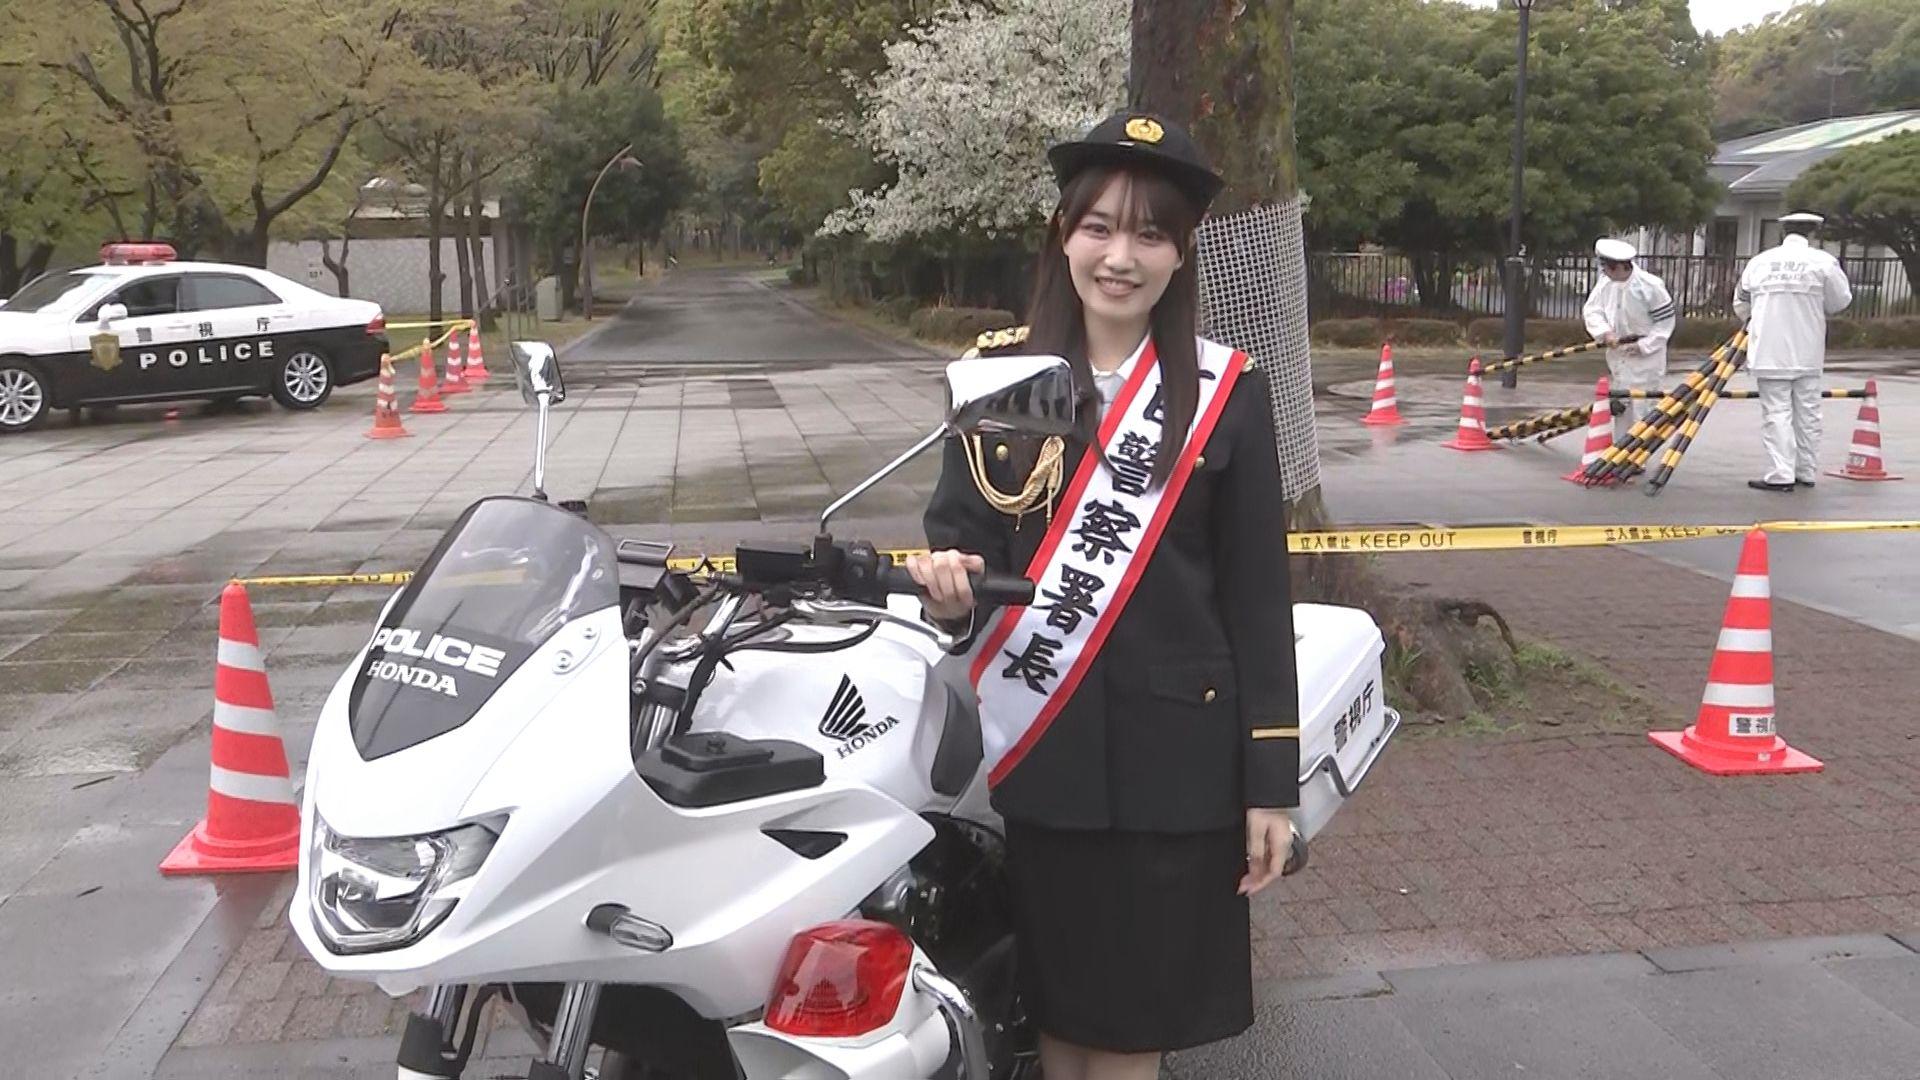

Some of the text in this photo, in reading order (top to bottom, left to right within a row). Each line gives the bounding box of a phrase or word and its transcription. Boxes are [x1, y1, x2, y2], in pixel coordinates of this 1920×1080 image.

[139, 340, 274, 370] POLICE
[1001, 368, 1217, 698] 警察署長
[1359, 532, 1411, 549] KEEP
[1419, 530, 1457, 548] OUT
[370, 626, 506, 679] POLICE
[366, 658, 459, 698] HONDA
[835, 715, 900, 760] HONDA
[1333, 679, 1375, 755] 警視庁
